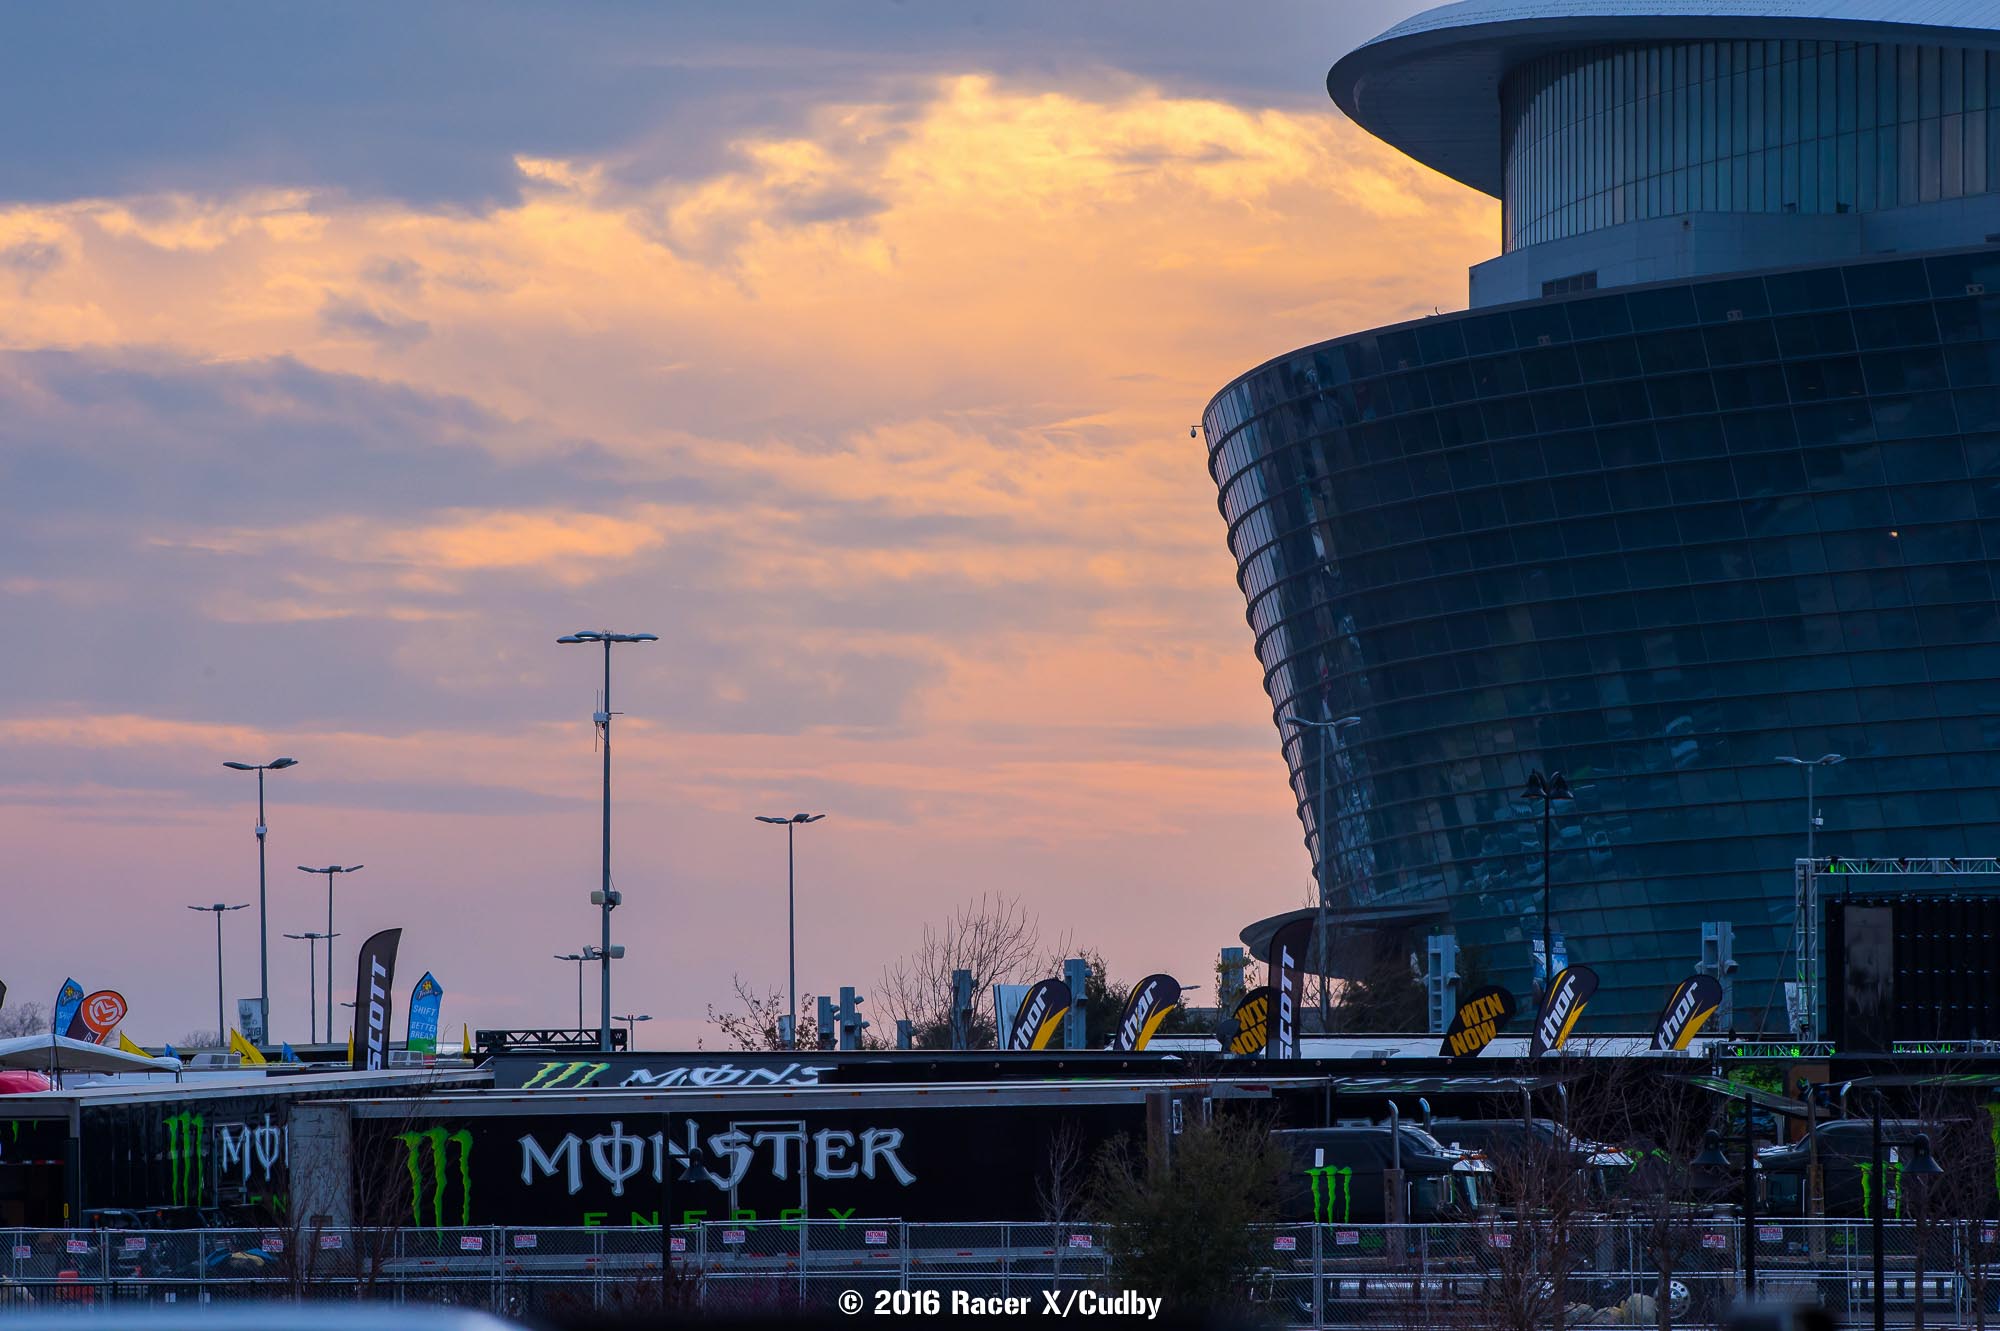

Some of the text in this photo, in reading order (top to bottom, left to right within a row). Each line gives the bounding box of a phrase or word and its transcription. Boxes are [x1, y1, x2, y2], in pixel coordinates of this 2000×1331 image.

[367, 954, 386, 1071] SCOTT
[410, 1031, 434, 1040] BREAD
[413, 1004, 436, 1016] SHIFT
[1121, 981, 1158, 1050] thor
[1460, 993, 1505, 1027] WIN
[1540, 974, 1576, 1049] thor
[1658, 981, 1698, 1050] thor
[1450, 1019, 1496, 1057] NOW
[518, 1119, 917, 1196] MONSTER
[583, 1208, 856, 1234] ENERGY
